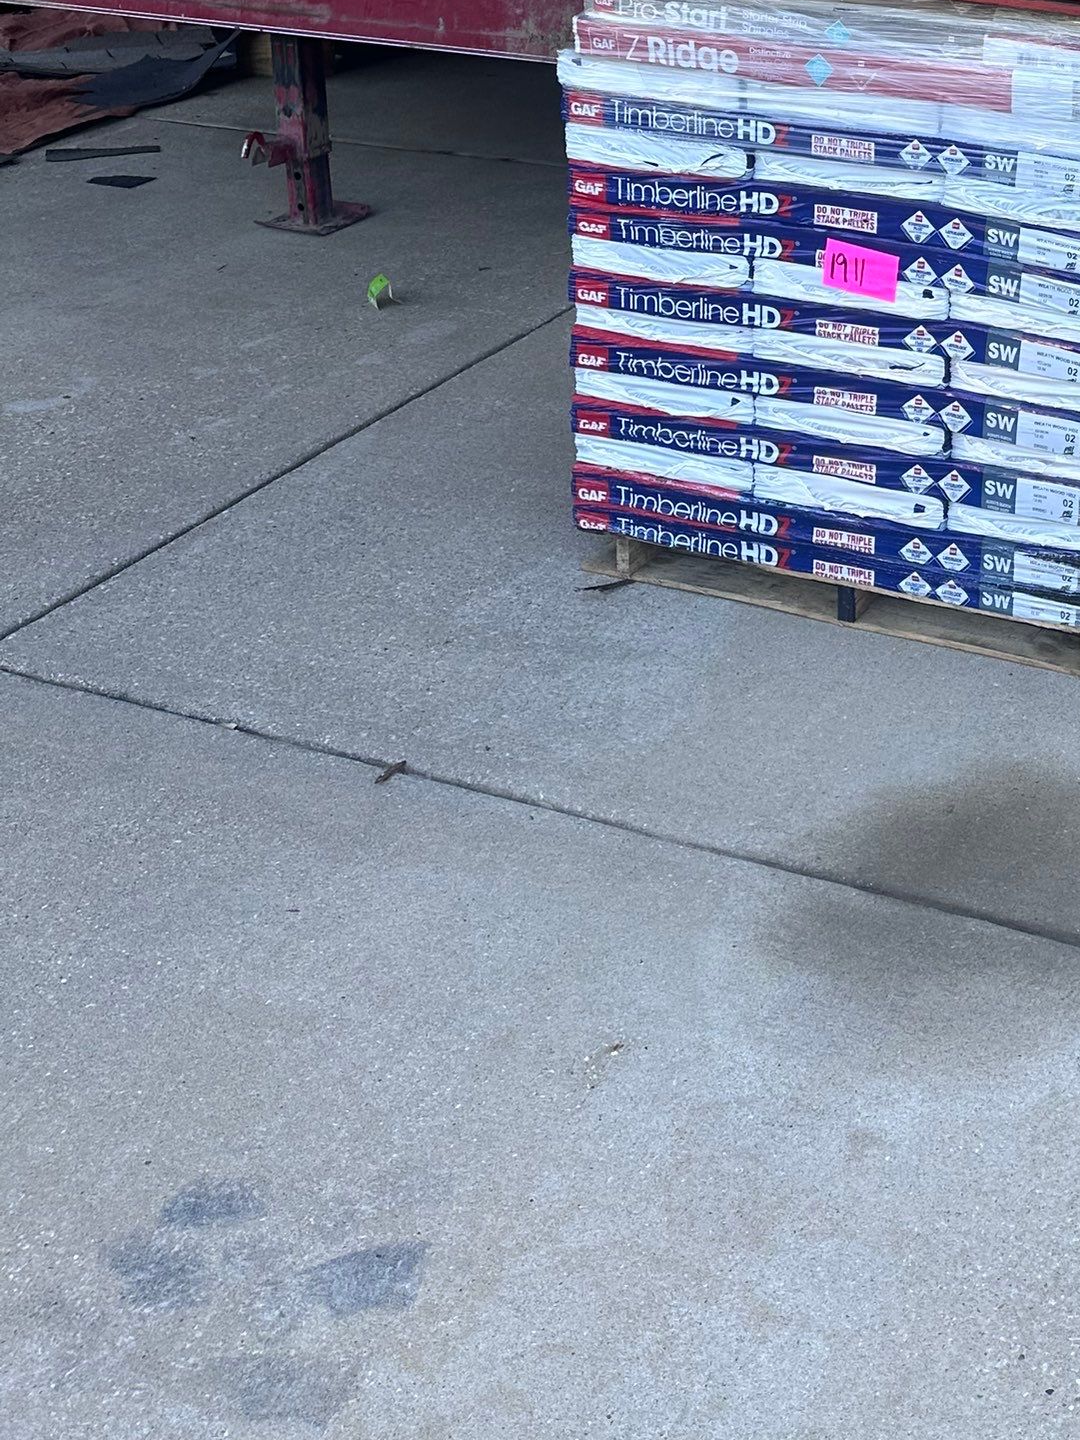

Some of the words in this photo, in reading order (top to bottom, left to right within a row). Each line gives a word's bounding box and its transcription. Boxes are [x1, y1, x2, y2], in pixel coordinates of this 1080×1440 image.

[592, 37, 617, 50] GAF
[623, 34, 644, 62] Z
[647, 36, 740, 74] Ridge
[571, 101, 600, 117] GAF
[813, 136, 824, 145] DO
[827, 137, 842, 147] NOT
[846, 139, 873, 151] TRIPLE
[813, 145, 839, 156] STACK
[840, 148, 872, 161] PALLETS
[984, 154, 1015, 173] SW
[1064, 173, 1076, 182] 02
[574, 179, 604, 196] GAF
[816, 205, 827, 215] DO
[830, 207, 845, 217] NOT
[849, 210, 875, 222] TRIPLE
[577, 221, 607, 234] GAF
[816, 214, 840, 225] STACK
[842, 218, 875, 231] PALLETS
[987, 228, 1018, 247] SW
[1066, 251, 1078, 260] 02
[829, 252, 865, 287] 1911
[988, 275, 1019, 297] SW
[577, 288, 607, 303] GAF
[1068, 297, 1080, 308] 02
[818, 329, 842, 340] STACK
[843, 333, 876, 346] PALLETS
[832, 323, 847, 332] NOT
[851, 325, 877, 337] TRIPLE
[987, 342, 1018, 363] SW
[577, 353, 606, 368] GAF
[1067, 367, 1079, 377] 02
[815, 395, 839, 407] STACK
[849, 393, 874, 405] TRIPLE
[578, 419, 607, 432] GAF
[986, 412, 1016, 432] SW
[1064, 433, 1076, 443] 02
[815, 464, 839, 475] STACK
[847, 461, 874, 473] TRIPLE
[577, 488, 607, 503] GAF
[984, 480, 1014, 500] SW
[1062, 499, 1074, 509] 02
[815, 529, 826, 539] DO
[828, 531, 843, 540] NOT
[847, 534, 872, 546] TRIPLE
[815, 562, 826, 571] DO
[828, 564, 843, 574] NOT
[847, 567, 872, 580] TRIPLE
[982, 553, 1012, 574] SW
[981, 591, 1011, 610] SW
[1060, 610, 1071, 621] 02
